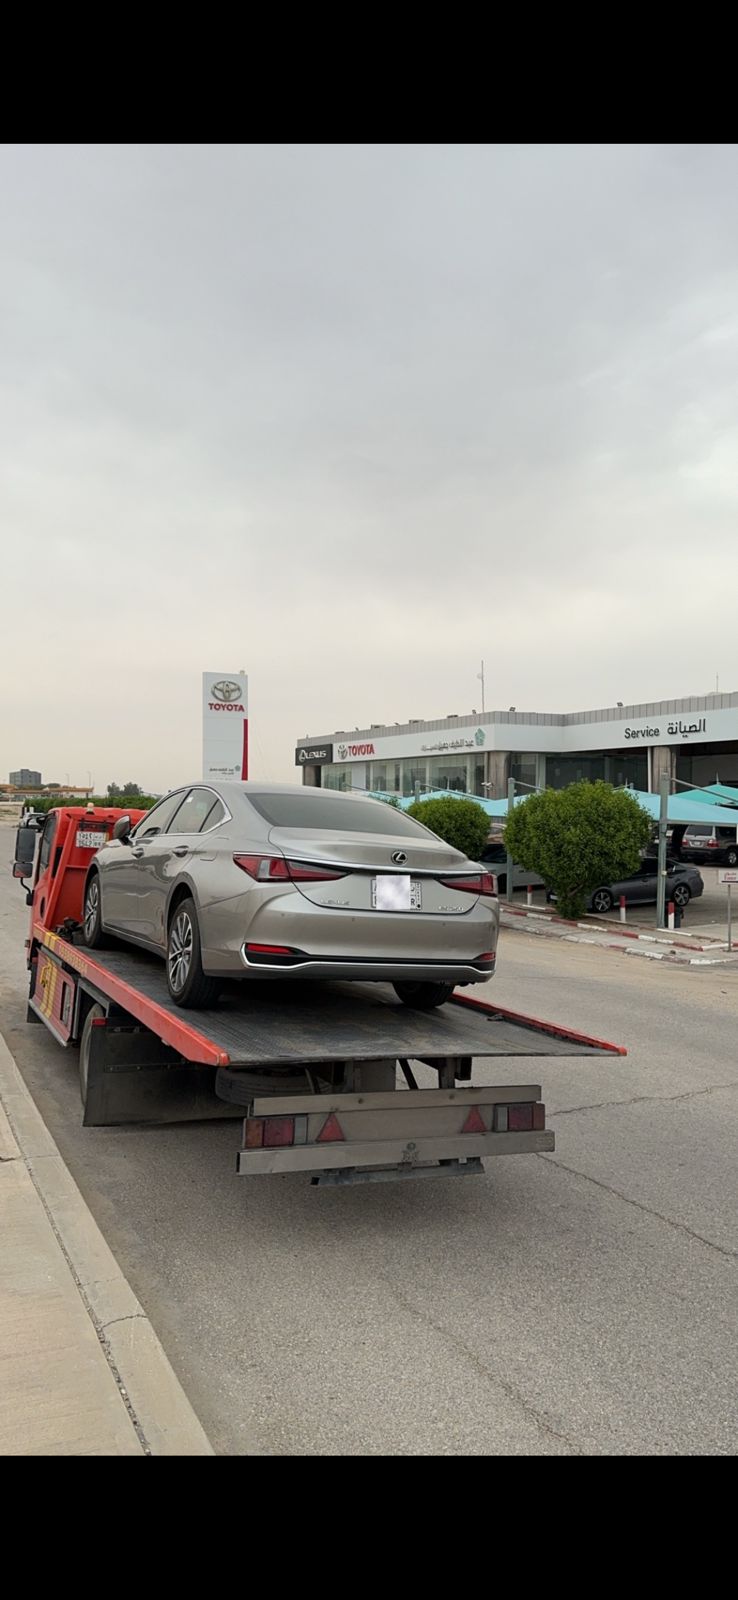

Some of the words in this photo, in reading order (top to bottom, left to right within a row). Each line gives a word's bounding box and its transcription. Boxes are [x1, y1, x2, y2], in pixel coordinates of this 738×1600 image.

[208, 702, 245, 712] TOYOTA
[624, 725, 660, 739] Service
[667, 718, 706, 738] الصيانة
[305, 749, 327, 759] LEXUS
[348, 744, 375, 756] TOYOTA
